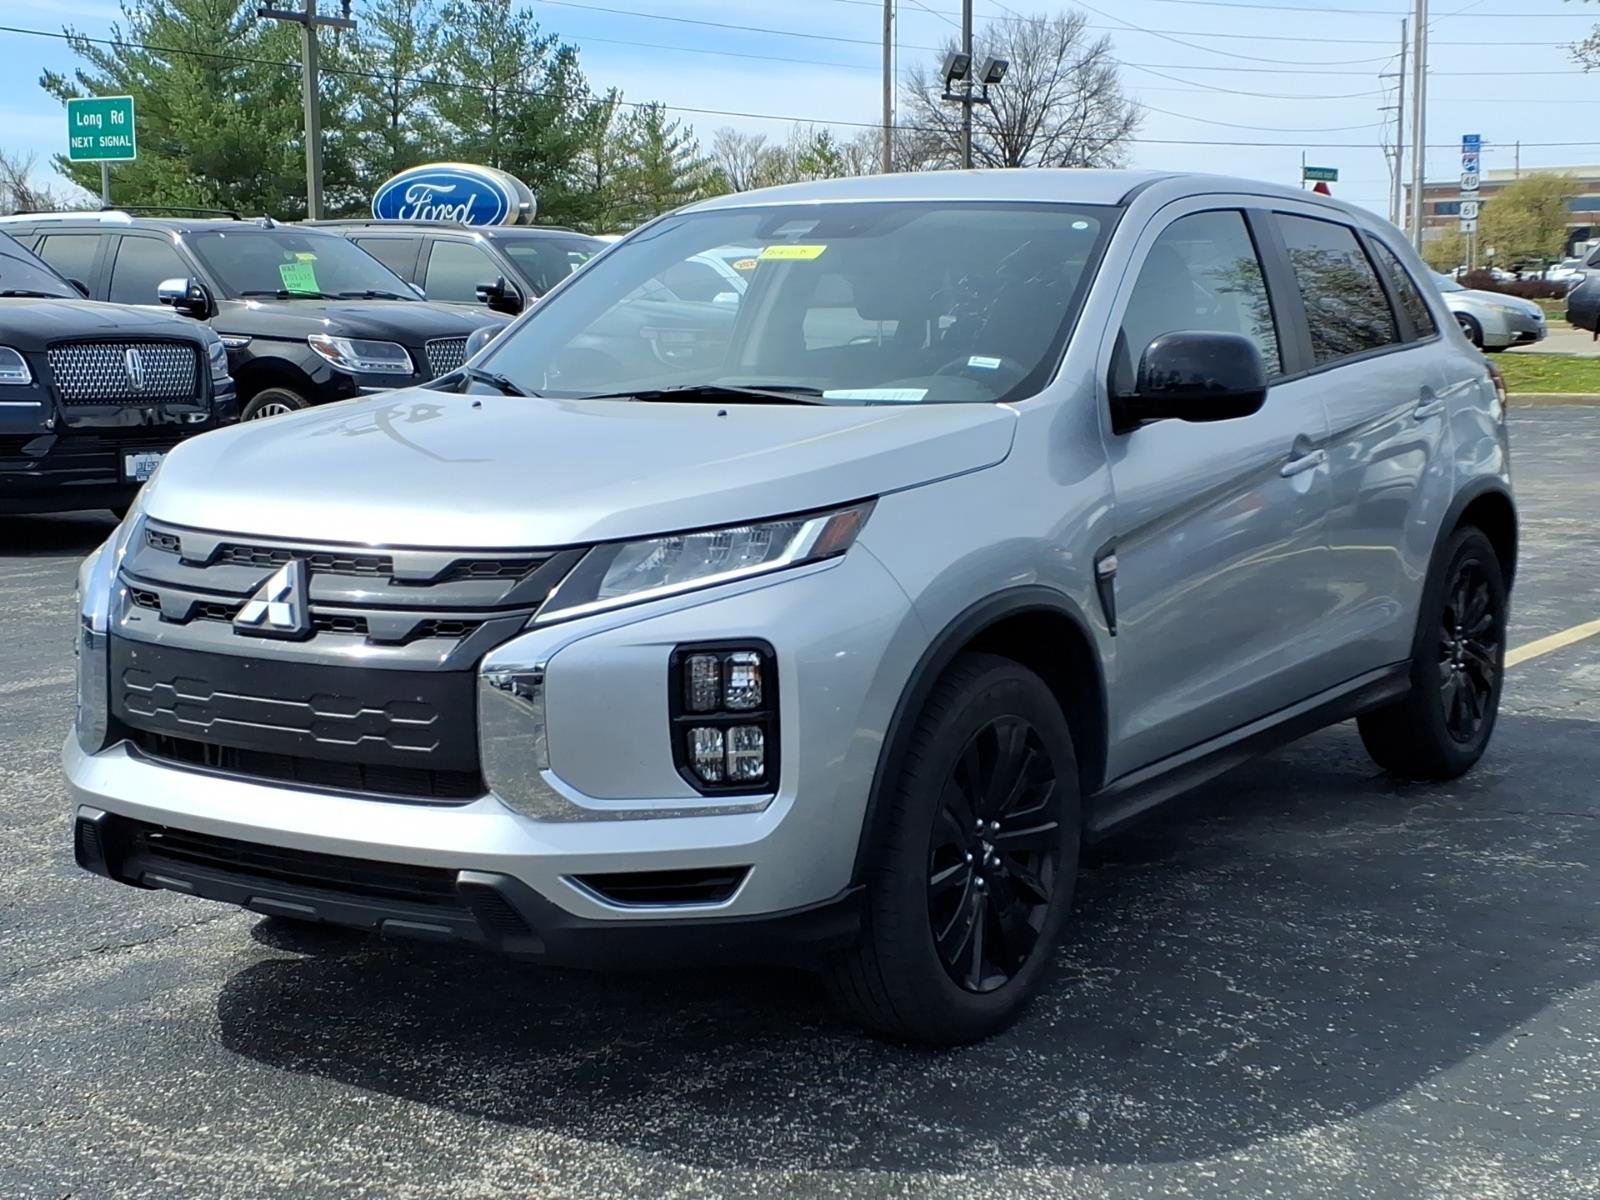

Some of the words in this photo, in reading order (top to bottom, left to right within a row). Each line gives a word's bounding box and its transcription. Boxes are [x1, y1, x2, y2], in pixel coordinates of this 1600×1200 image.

[76, 111, 103, 129] Long
[110, 110, 125, 125] Rd
[71, 136, 94, 149] NEXT
[99, 135, 132, 147] SIGNAL
[1463, 176, 1478, 187] 40
[399, 183, 477, 225] Ford
[1463, 204, 1477, 217] 61
